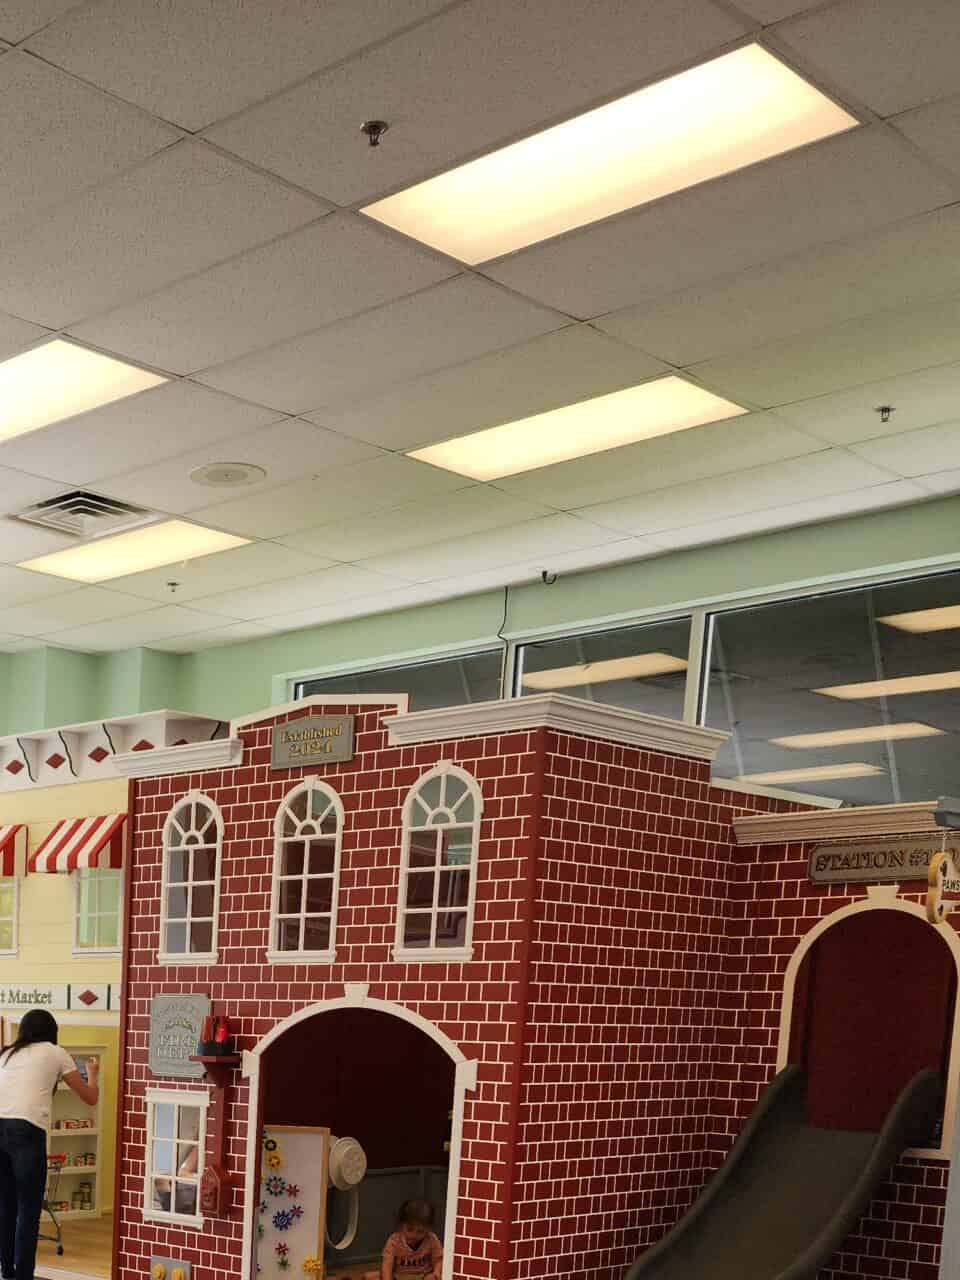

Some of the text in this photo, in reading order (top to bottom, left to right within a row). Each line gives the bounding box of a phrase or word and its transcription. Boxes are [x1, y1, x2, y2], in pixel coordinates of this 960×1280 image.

[280, 724, 344, 744] Established
[815, 850, 906, 872] STATION
[7, 987, 52, 1004] Market
